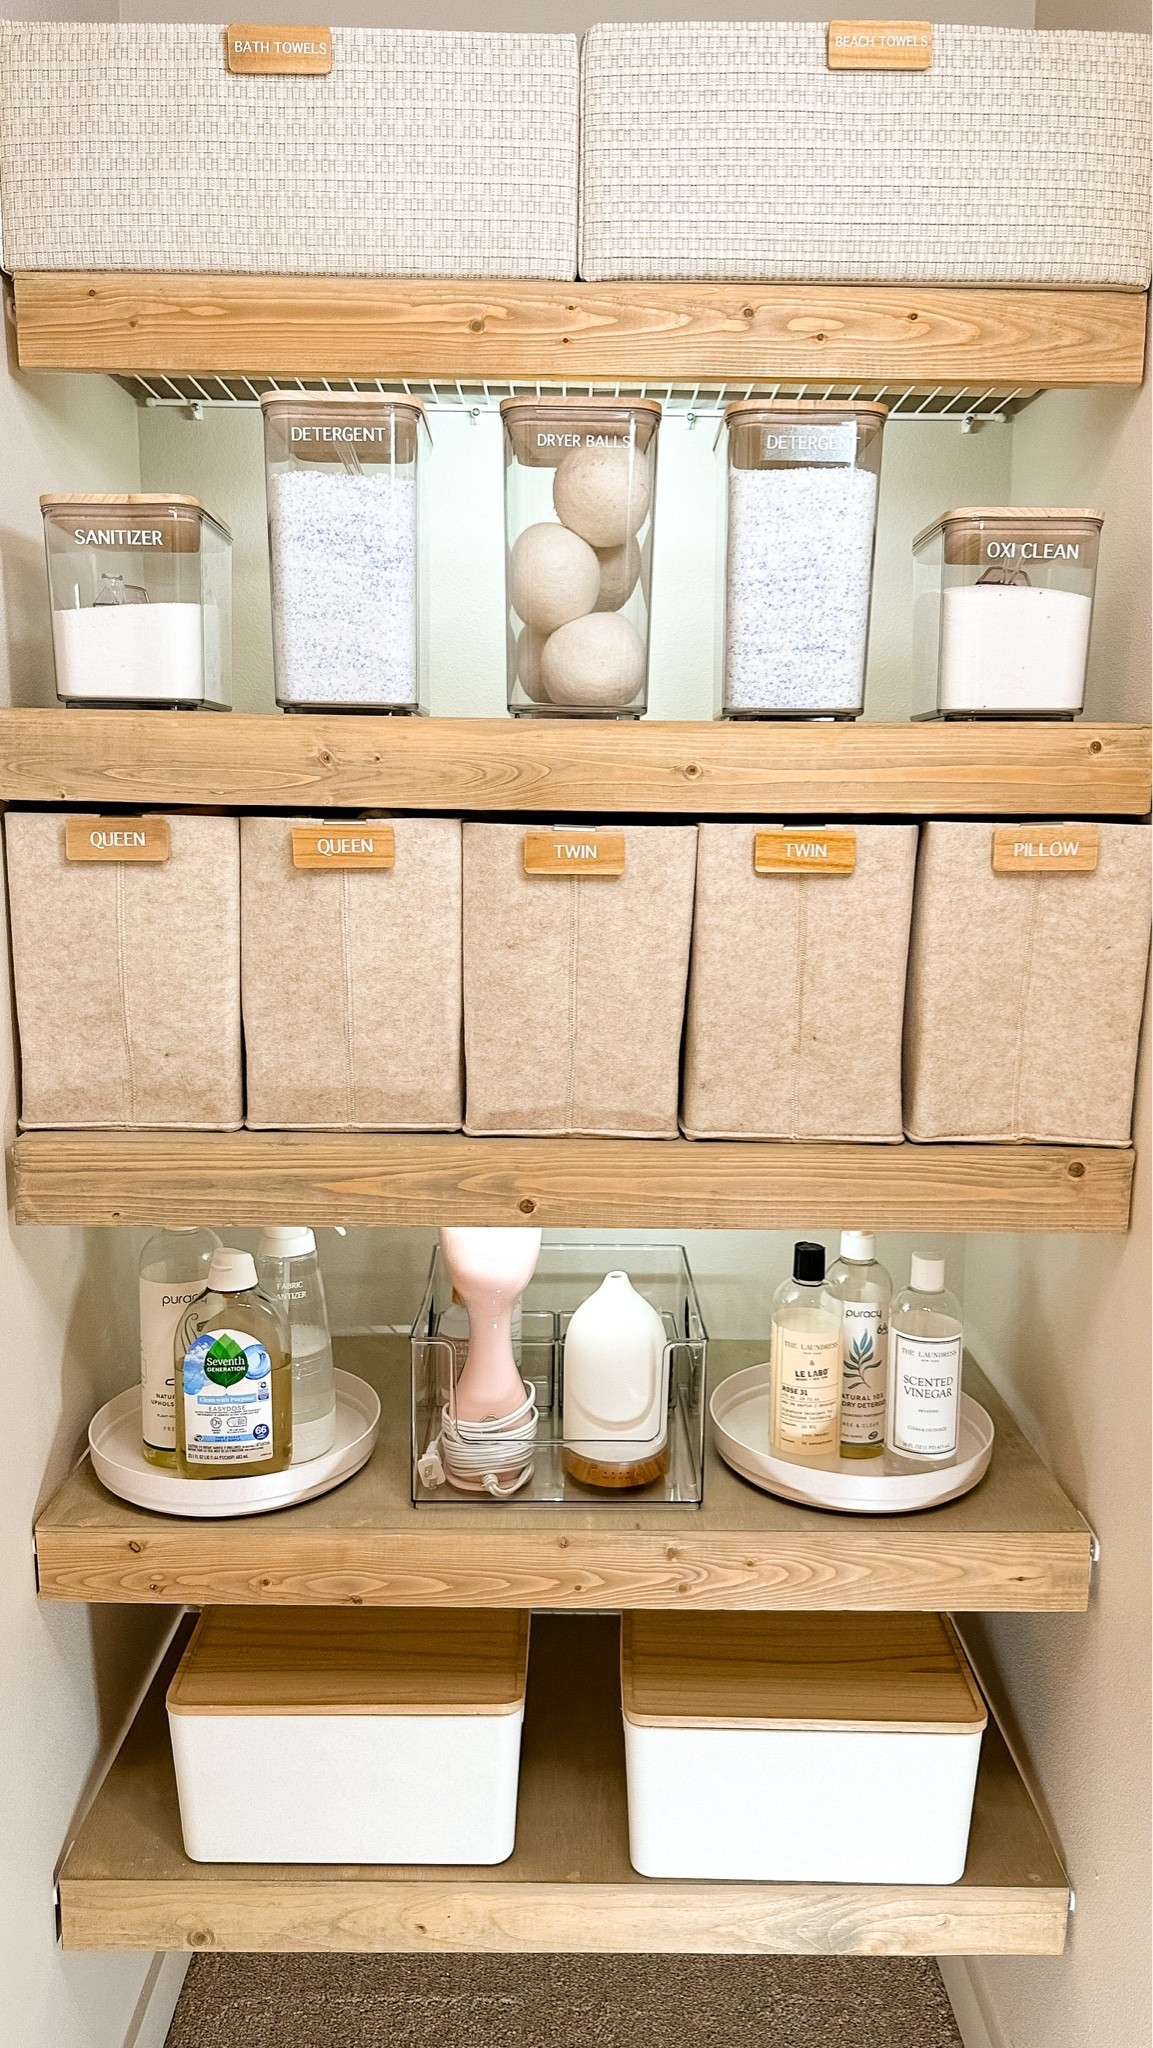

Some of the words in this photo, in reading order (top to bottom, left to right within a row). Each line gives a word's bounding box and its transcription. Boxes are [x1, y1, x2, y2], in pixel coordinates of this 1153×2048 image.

[234, 41, 270, 54] BATH
[273, 42, 328, 55] TOWELS
[835, 36, 875, 48] BEACH
[879, 35, 929, 47] TOWELS
[291, 426, 386, 442] DETERGENT
[537, 433, 581, 447] DRYER
[586, 435, 631, 449] BALLS
[74, 528, 163, 546] SANITIZER
[987, 542, 1016, 559] OXI
[1021, 542, 1080, 560] CLEAN
[90, 831, 146, 849] QUEEN
[317, 838, 374, 857] QUEEN
[553, 844, 598, 859] TWIN
[783, 843, 828, 858] TWIN
[1013, 841, 1080, 857] PILLOW
[276, 1281, 304, 1290] FABRIC
[845, 1309, 882, 1319] puracy
[901, 1347, 915, 1356] THE
[206, 1356, 245, 1366] Seventh
[795, 1370, 806, 1378] LE
[903, 1374, 954, 1387] SCENTED
[781, 1385, 799, 1394] ROSE
[903, 1385, 952, 1399] VINEGAR
[151, 1399, 175, 1407] UPHOLS
[254, 1425, 267, 1435] 66
